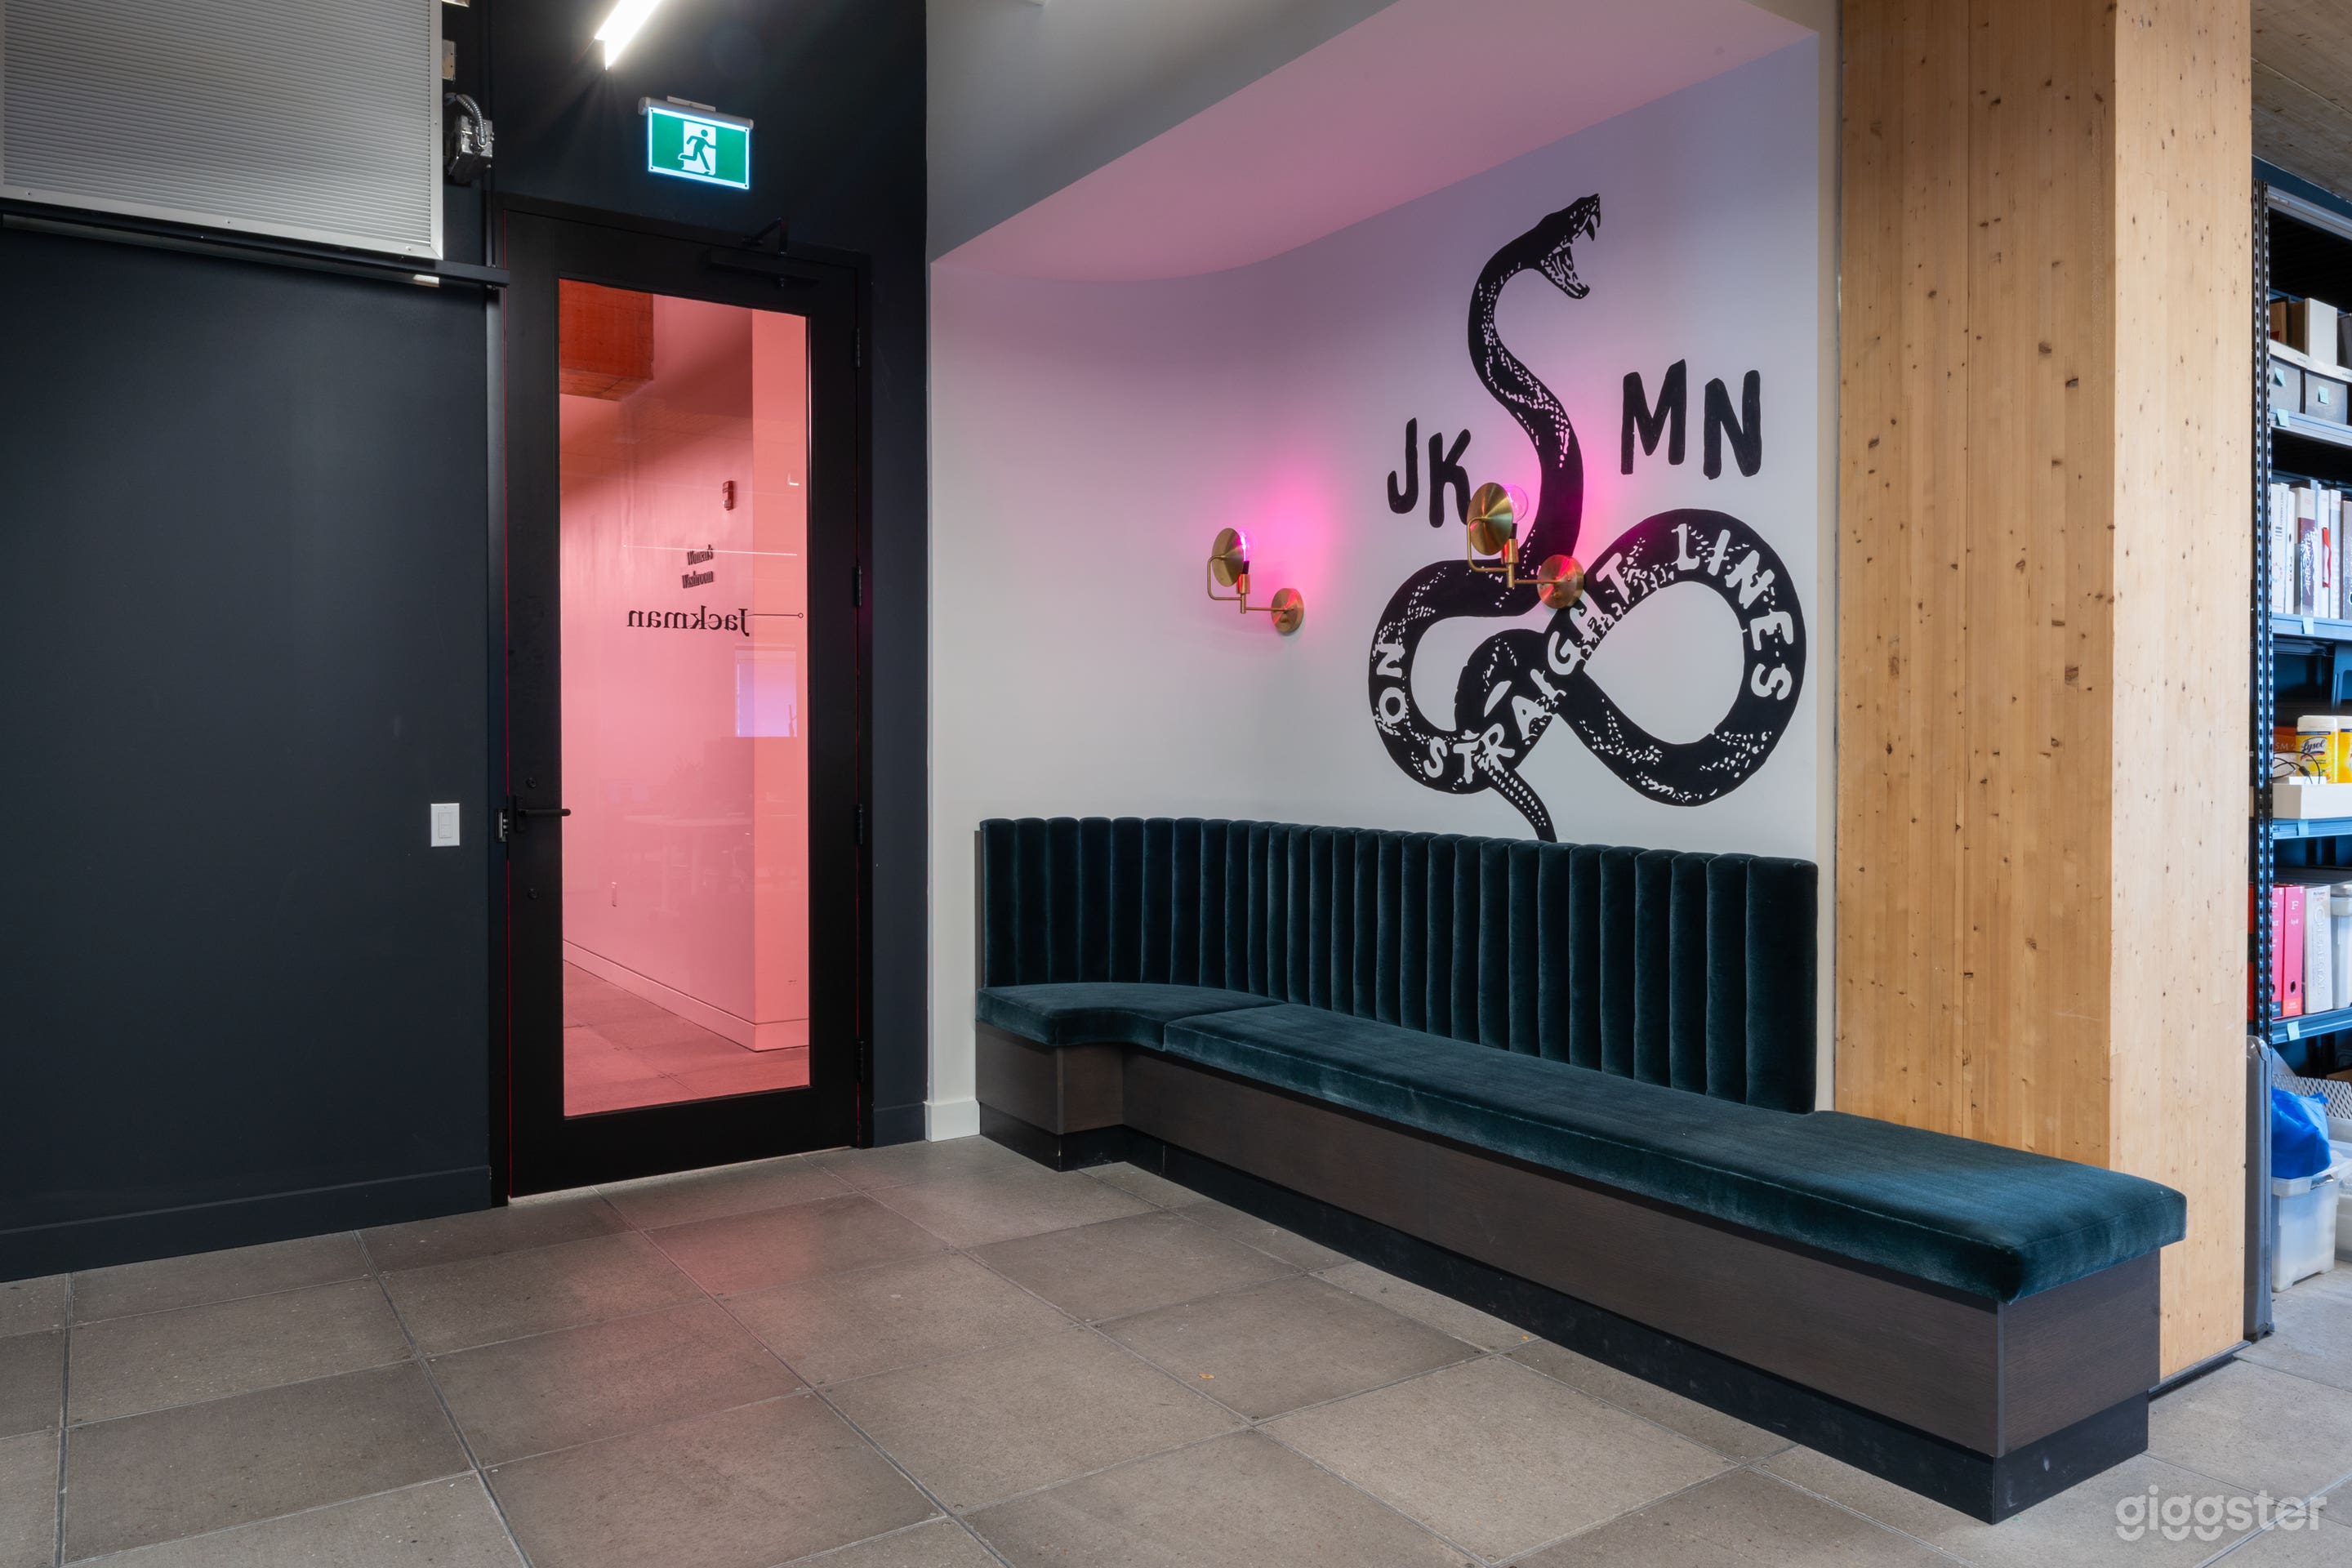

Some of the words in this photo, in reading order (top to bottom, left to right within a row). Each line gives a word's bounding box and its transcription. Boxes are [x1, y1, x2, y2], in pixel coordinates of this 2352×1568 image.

[1388, 417, 1471, 528] JK
[1621, 359, 1762, 480] MN
[1374, 641, 1406, 724] NO
[1423, 553, 1630, 784] STRAIGHT
[1671, 523, 1794, 701] LINES
[2301, 738, 2326, 753] Lysol
